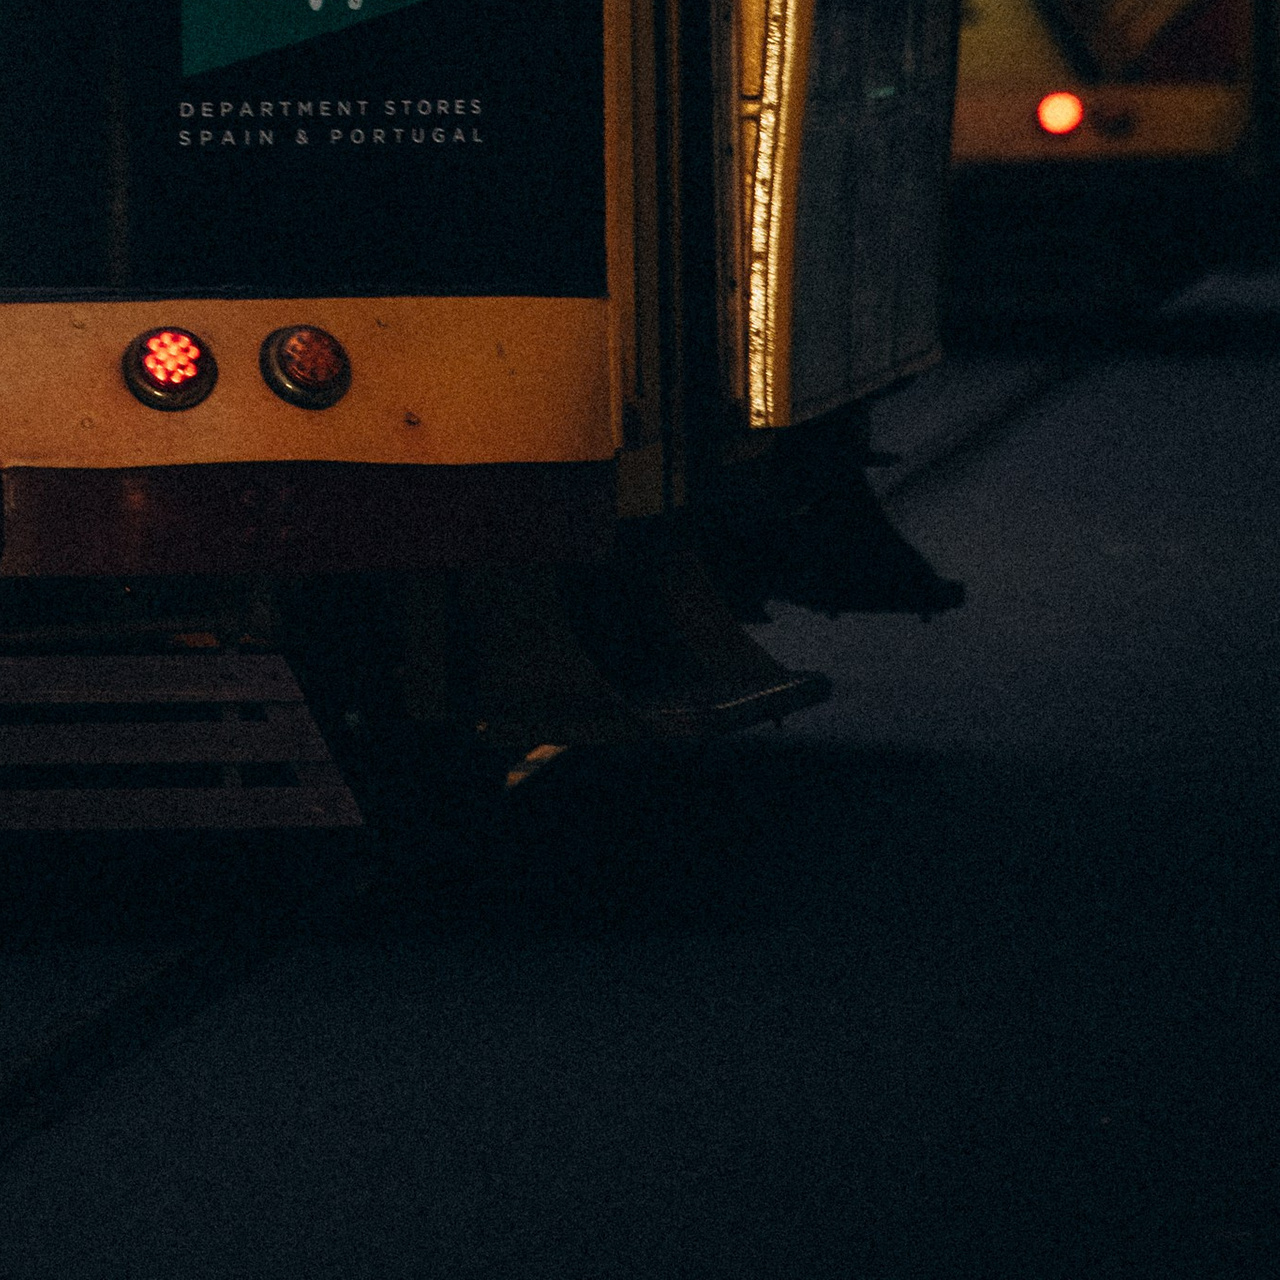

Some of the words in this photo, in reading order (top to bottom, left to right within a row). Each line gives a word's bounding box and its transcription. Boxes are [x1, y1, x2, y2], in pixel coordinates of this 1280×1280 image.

[178, 99, 370, 118] DEPARTMENT
[383, 98, 483, 116] STORES
[178, 129, 274, 146] SPAIN
[294, 128, 310, 145] &
[330, 127, 484, 145] PORTUGAL
